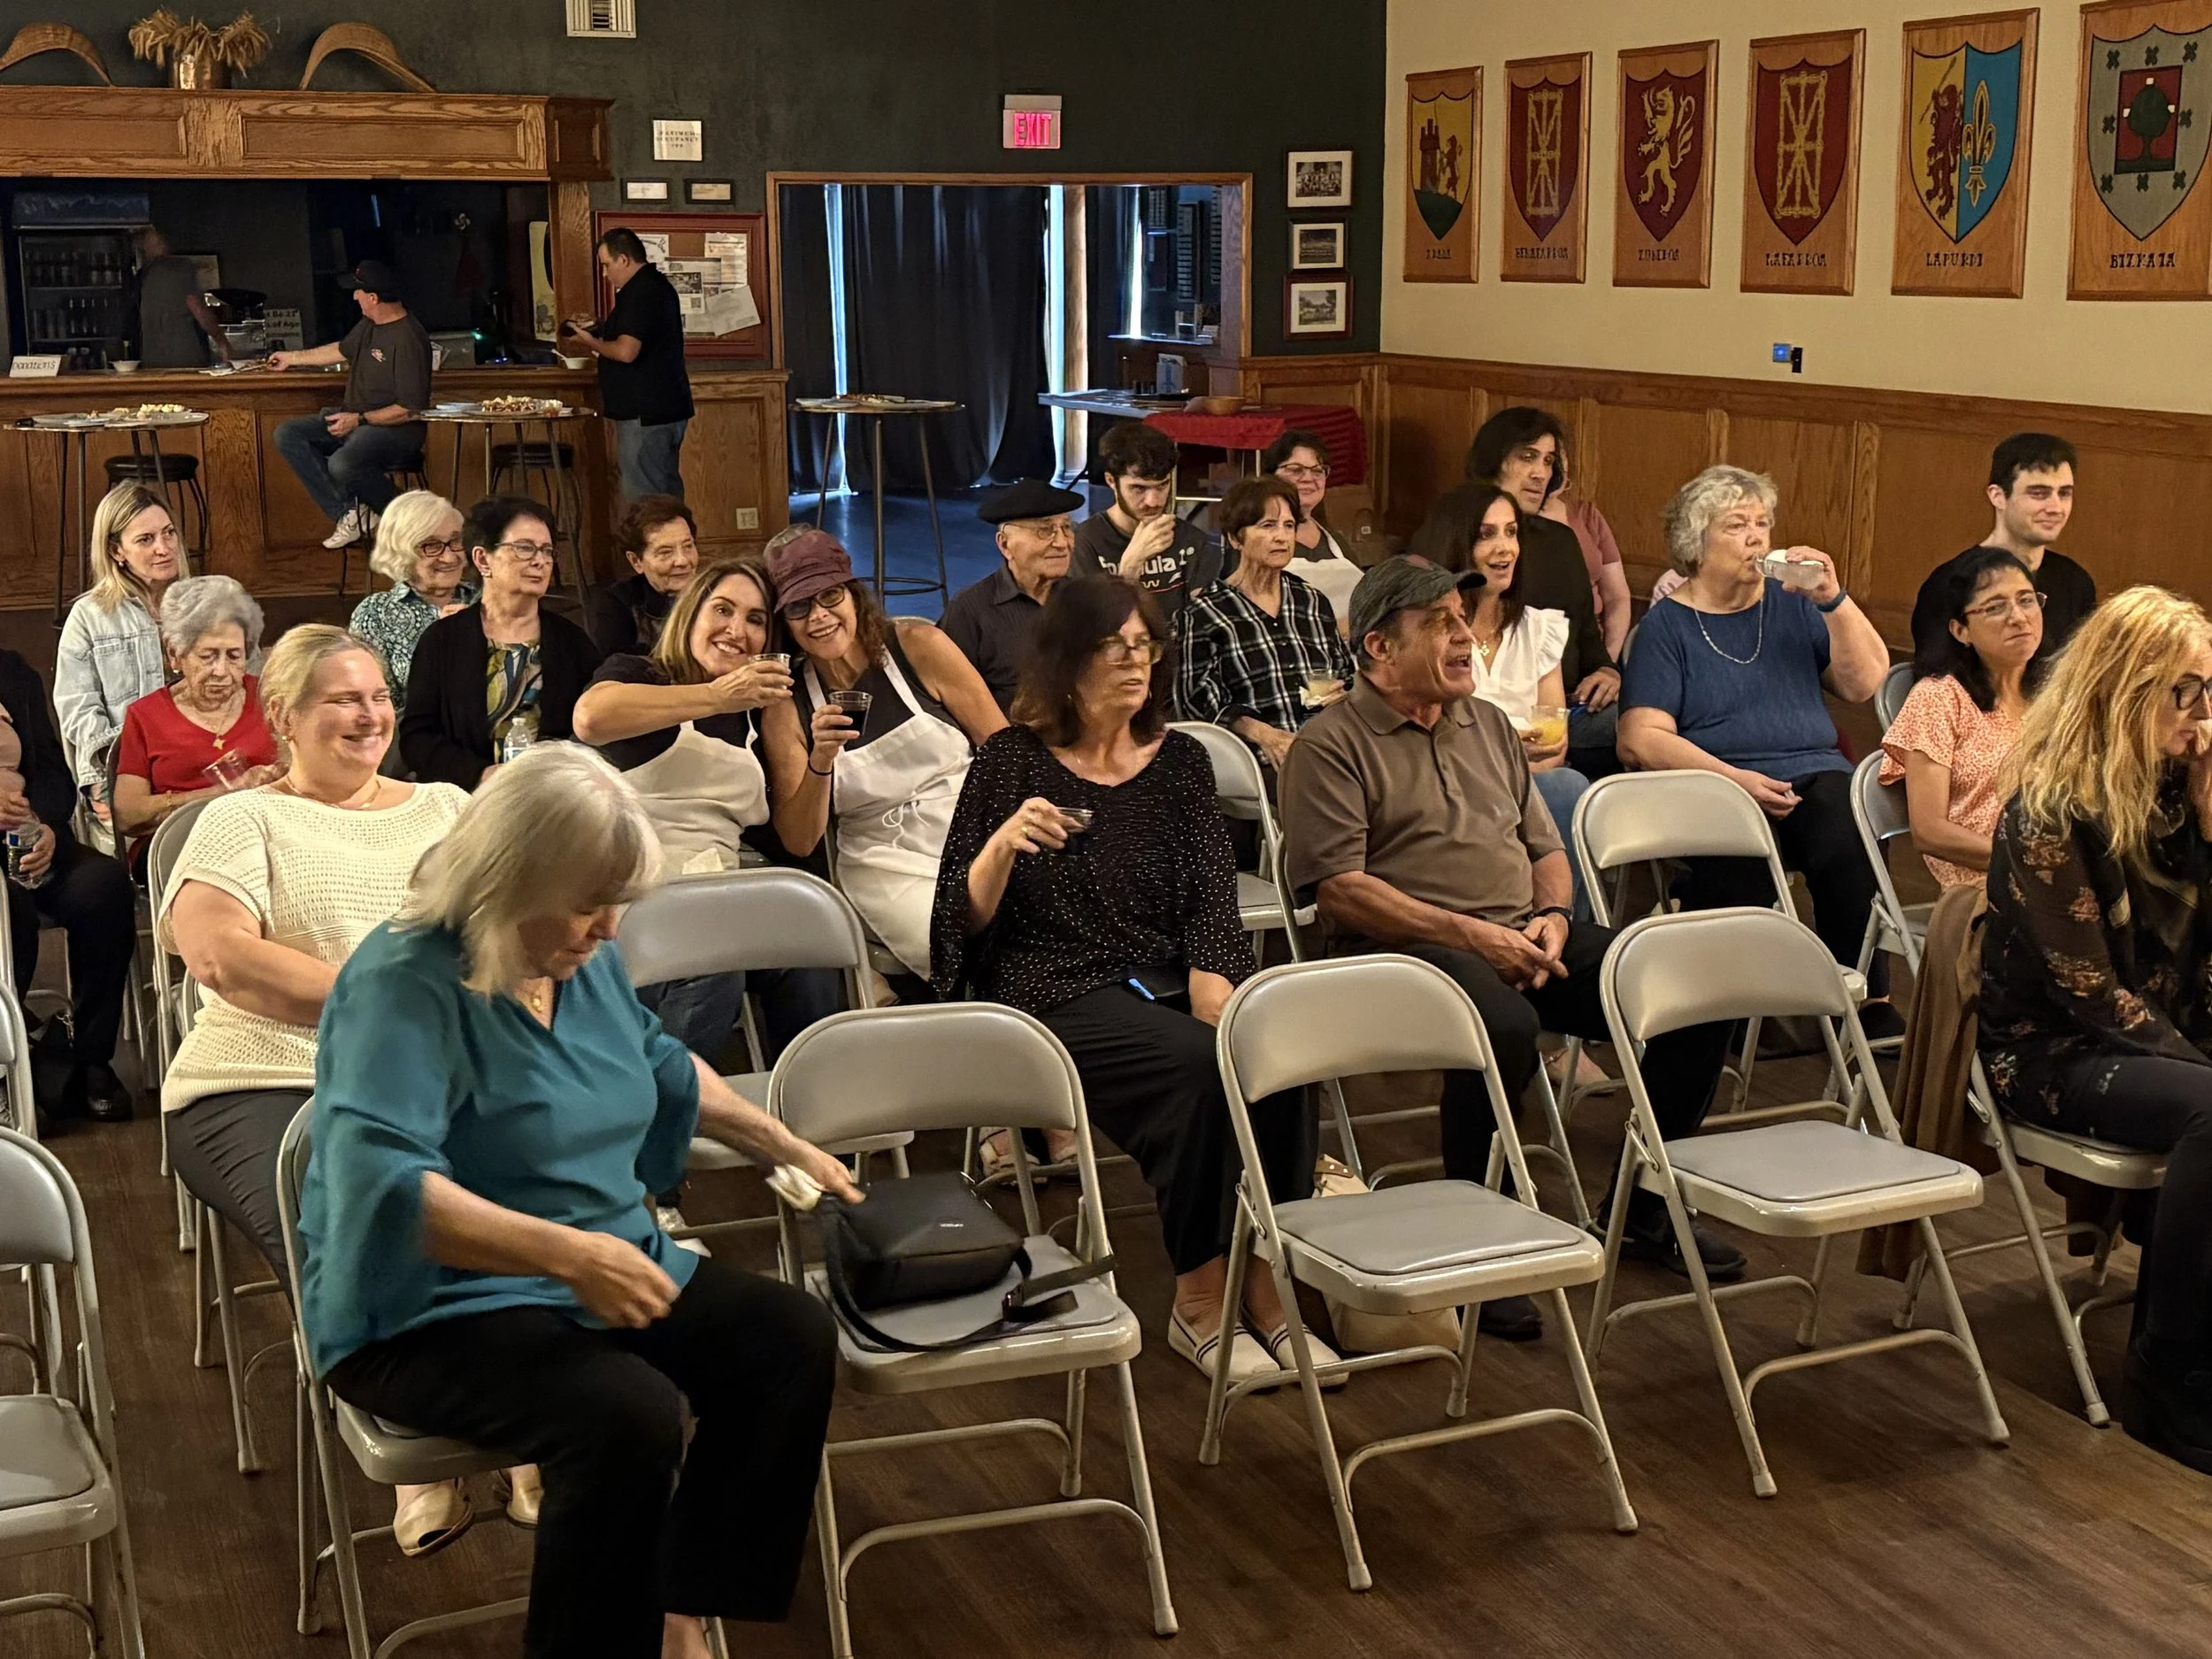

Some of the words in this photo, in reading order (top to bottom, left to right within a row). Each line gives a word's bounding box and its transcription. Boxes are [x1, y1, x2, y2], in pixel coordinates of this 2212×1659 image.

[1014, 112, 1052, 146] EXIT
[1926, 253, 1983, 266] LAPURDI
[2110, 253, 2175, 268] BIZKAIA
